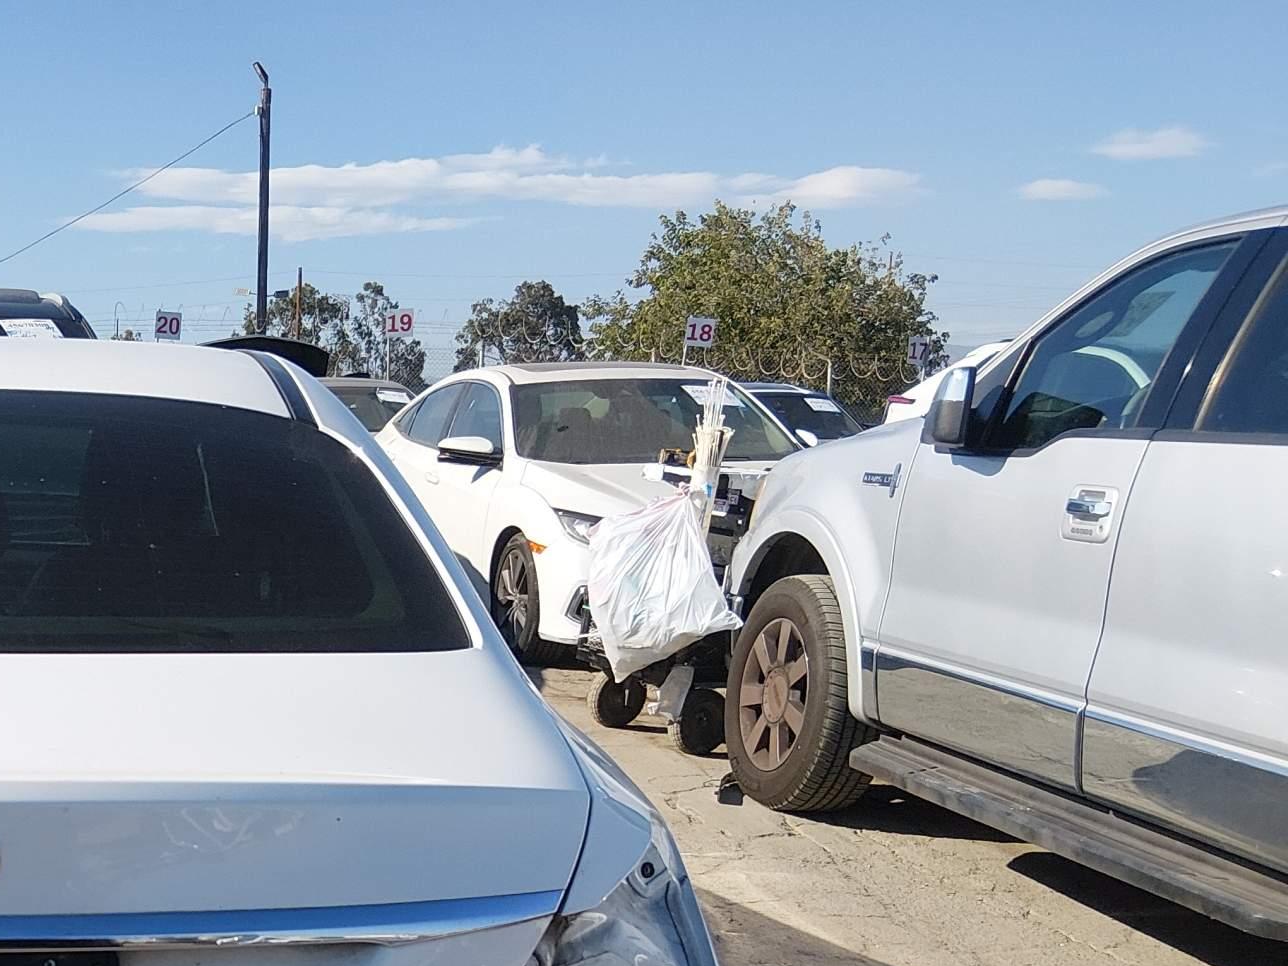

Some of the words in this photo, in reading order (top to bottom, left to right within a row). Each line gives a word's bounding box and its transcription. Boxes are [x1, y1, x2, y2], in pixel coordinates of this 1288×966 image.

[156, 316, 180, 335] 20
[387, 313, 412, 333] 19
[686, 323, 712, 342] 18
[909, 342, 929, 360] 17
